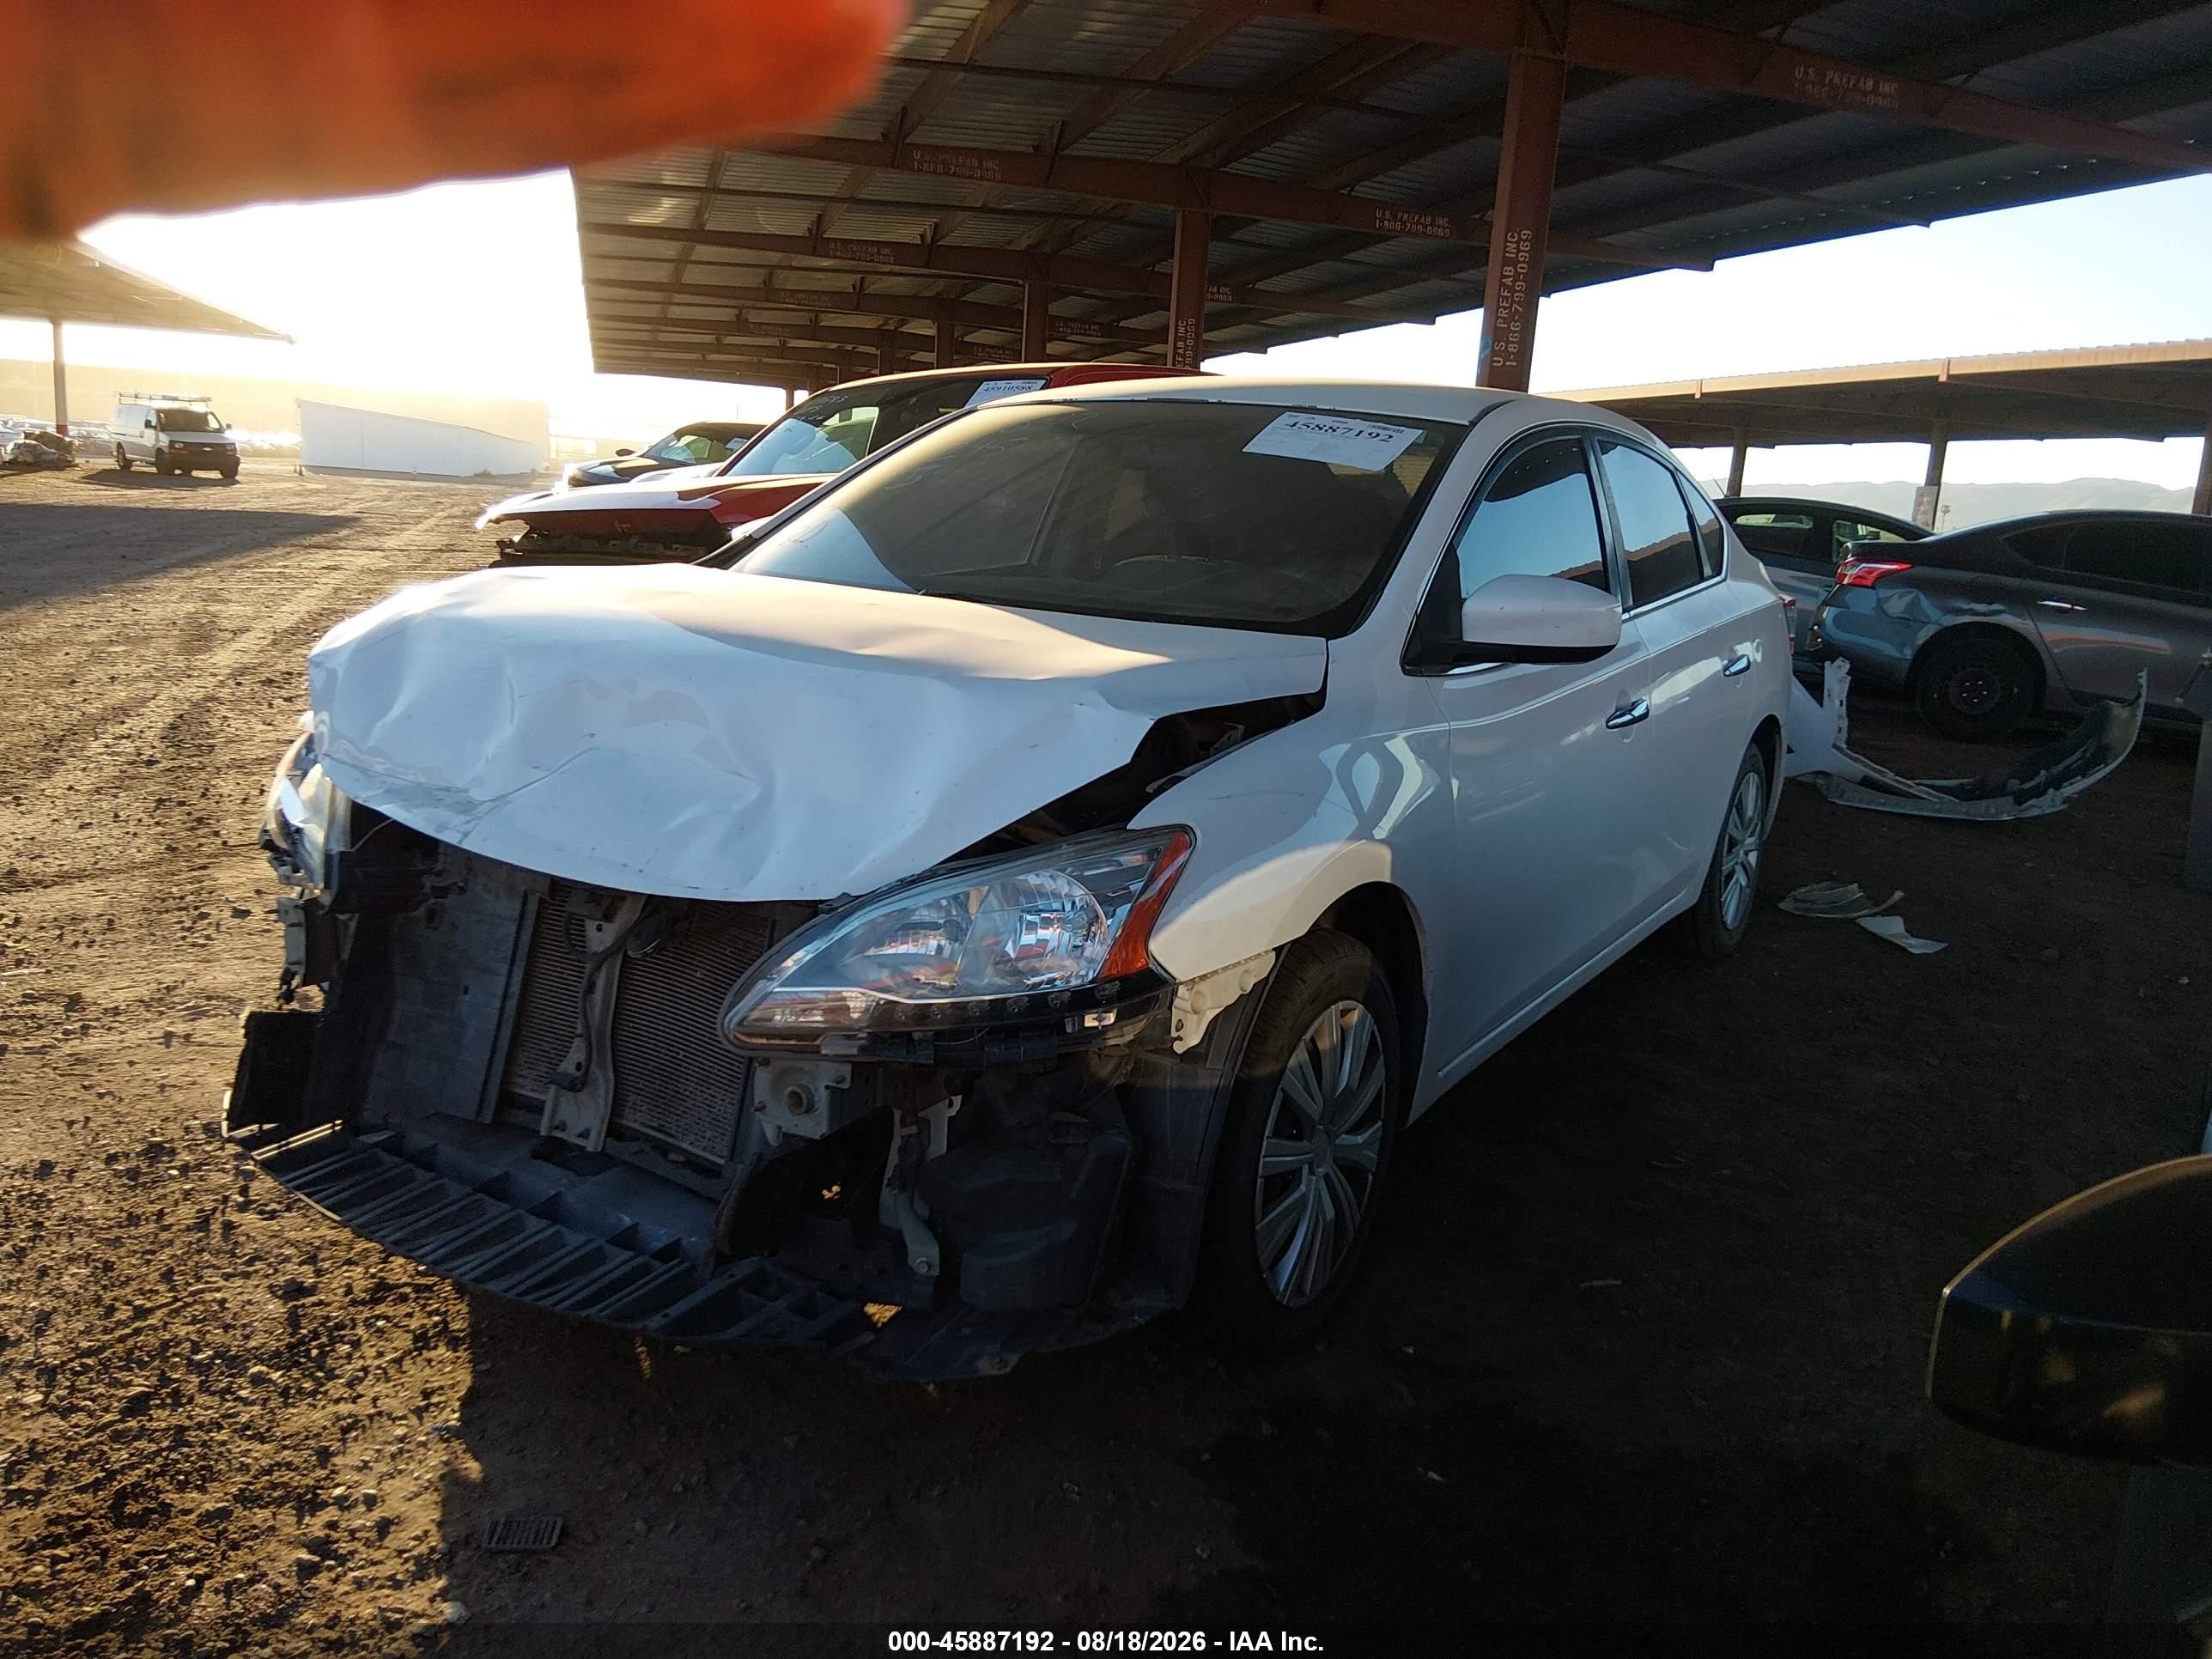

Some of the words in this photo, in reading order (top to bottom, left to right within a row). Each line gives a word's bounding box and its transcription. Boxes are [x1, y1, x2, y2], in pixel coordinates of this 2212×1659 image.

[1376, 209, 1392, 220] U.S.
[1397, 212, 1431, 225] PREFAB
[1436, 216, 1451, 228] INC.
[1505, 228, 1520, 258] INC.
[1497, 265, 1515, 327] PREFAB
[1505, 230, 1532, 366] 1-866-799-0969
[1176, 341, 1185, 367] EFAB
[1492, 337, 1505, 367] U.S.
[1285, 421, 1394, 443] 45887192
